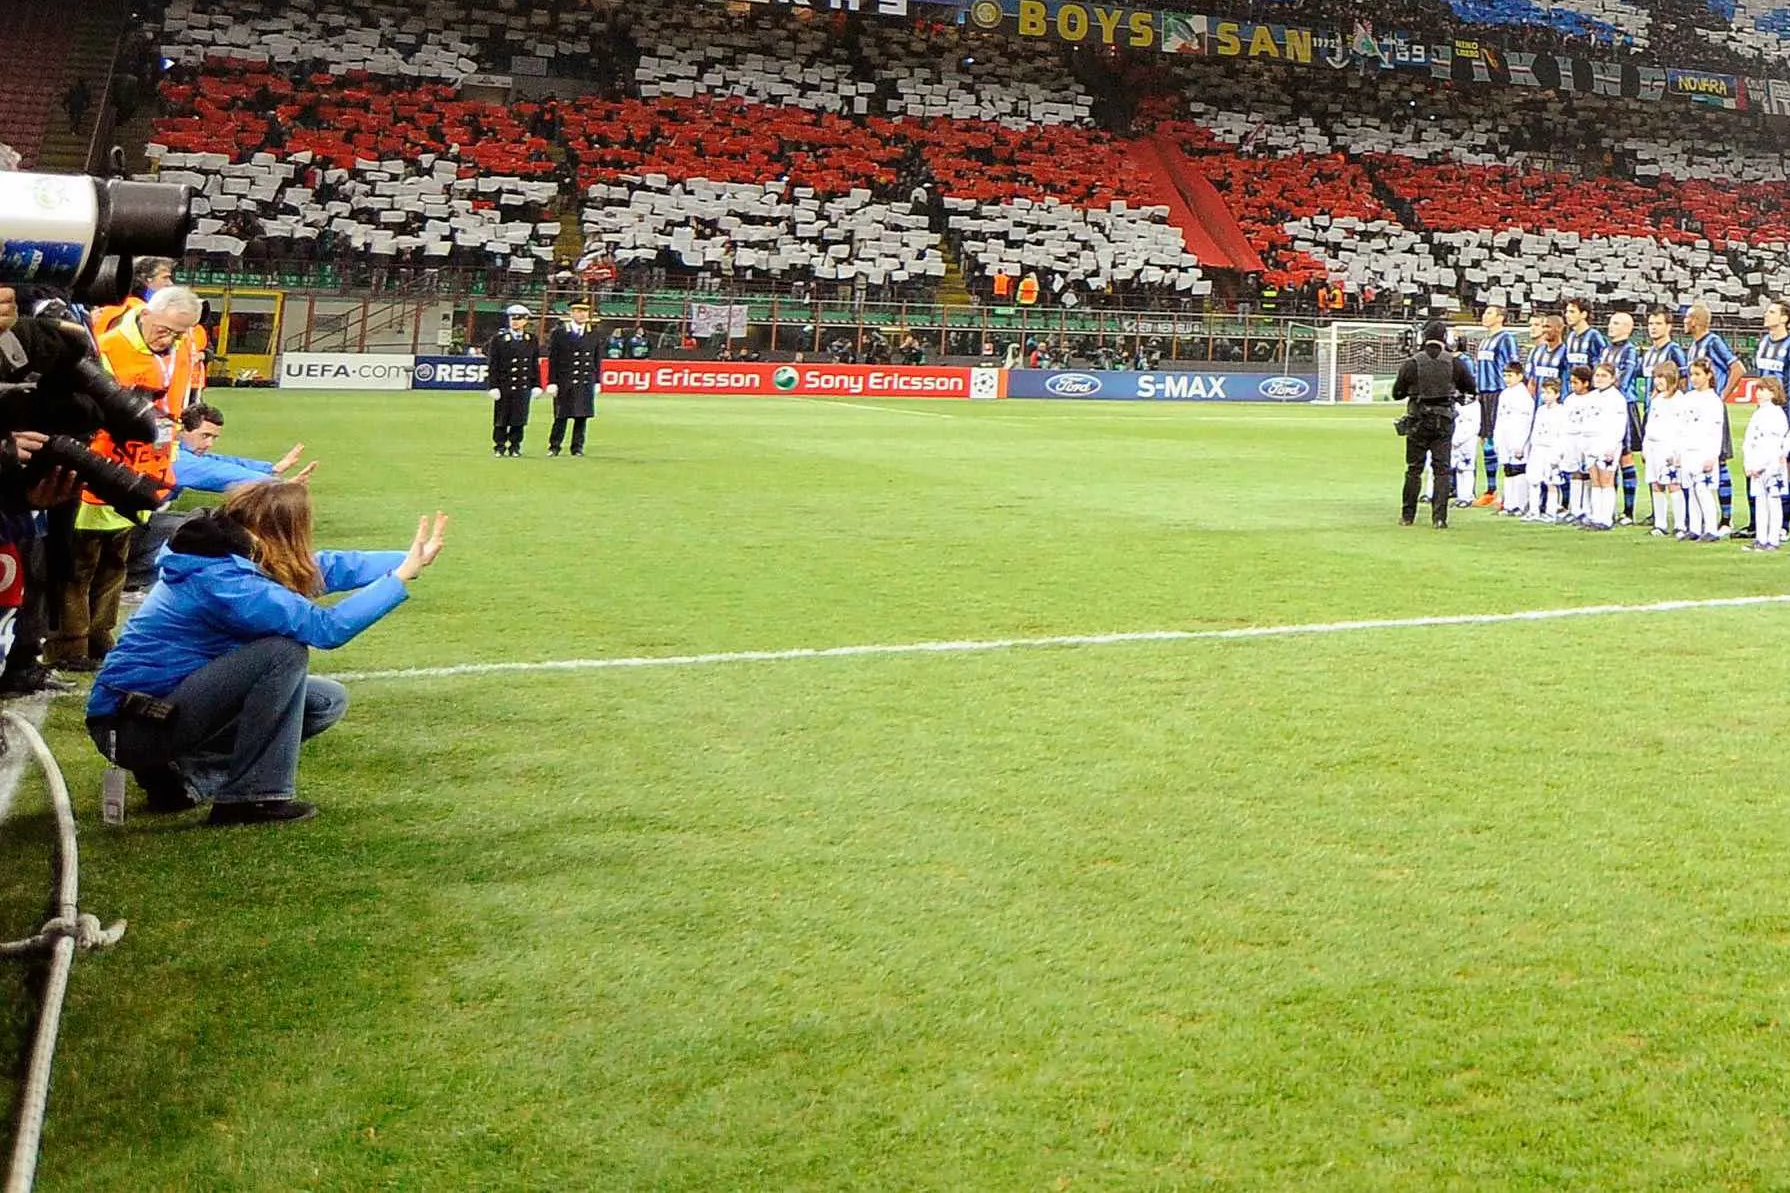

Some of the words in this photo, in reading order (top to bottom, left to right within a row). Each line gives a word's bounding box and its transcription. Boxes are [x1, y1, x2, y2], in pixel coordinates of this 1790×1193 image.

[1018, 0, 1154, 48] BOYS
[1216, 21, 1312, 64] SAN
[1678, 74, 1728, 95] NOVARA
[602, 369, 651, 391] ony
[656, 367, 761, 388] Ericsson
[805, 369, 863, 393] Sony
[868, 372, 964, 391] Ericsson
[1055, 376, 1091, 393] Ford
[1136, 374, 1227, 398] S-MAX
[1266, 378, 1301, 395] Ford
